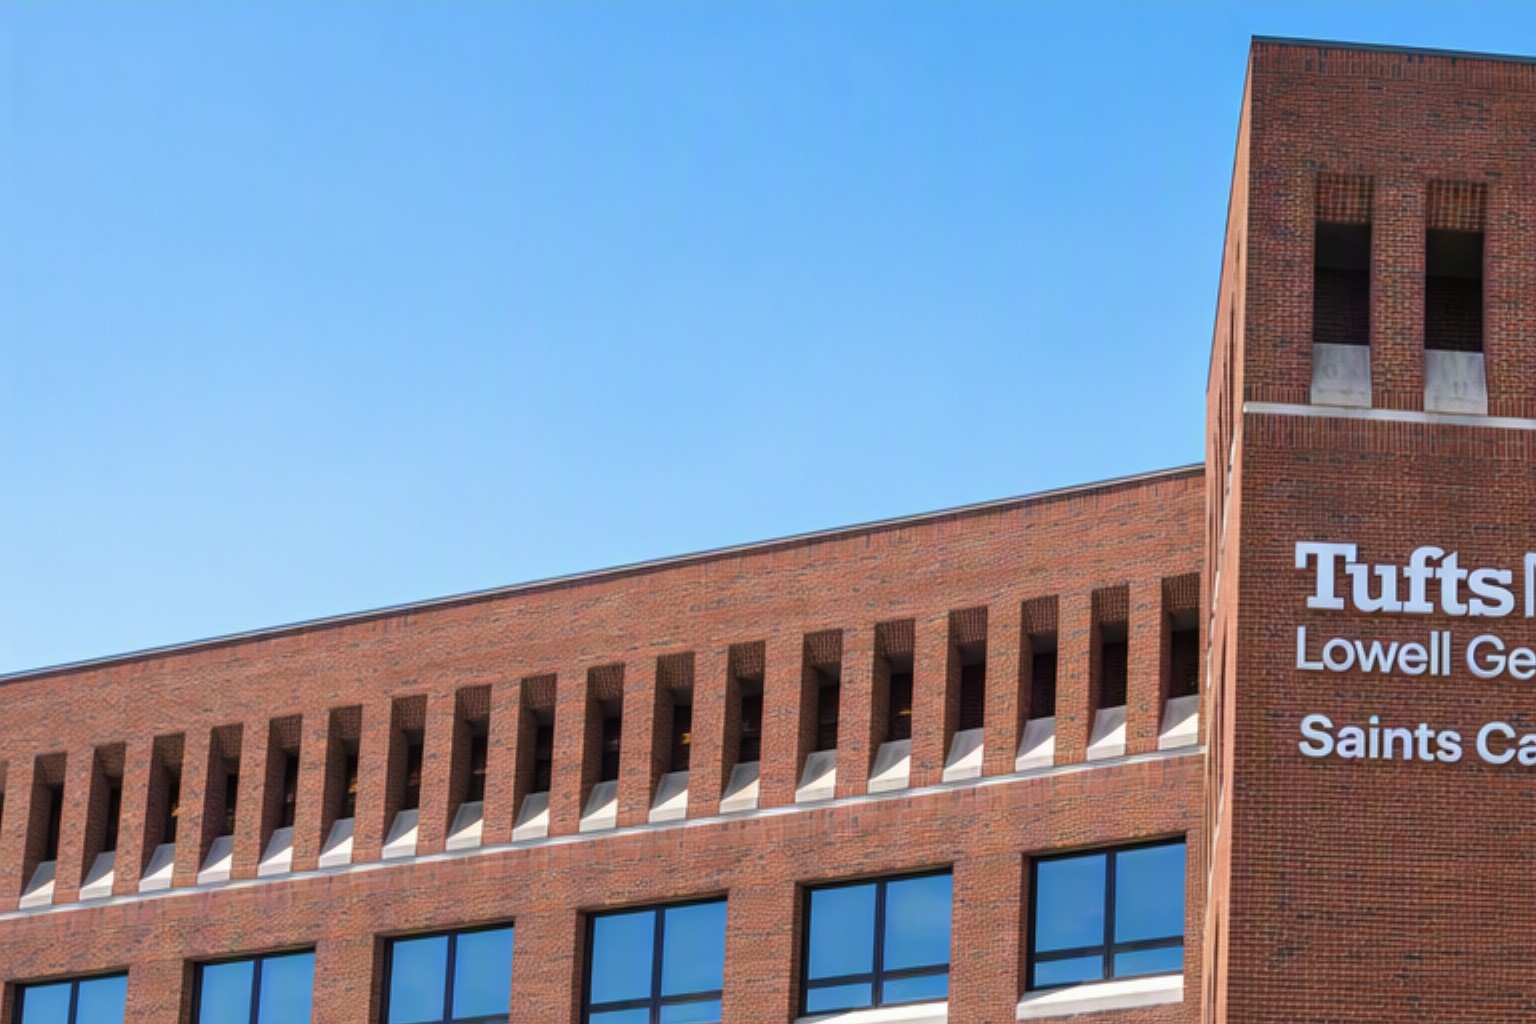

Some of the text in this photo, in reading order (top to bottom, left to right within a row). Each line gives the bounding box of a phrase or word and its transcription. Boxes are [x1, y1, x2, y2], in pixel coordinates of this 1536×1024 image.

[1294, 540, 1516, 618] Tufts
[1296, 625, 1451, 677] Lowell
[1298, 713, 1464, 764] Saints
